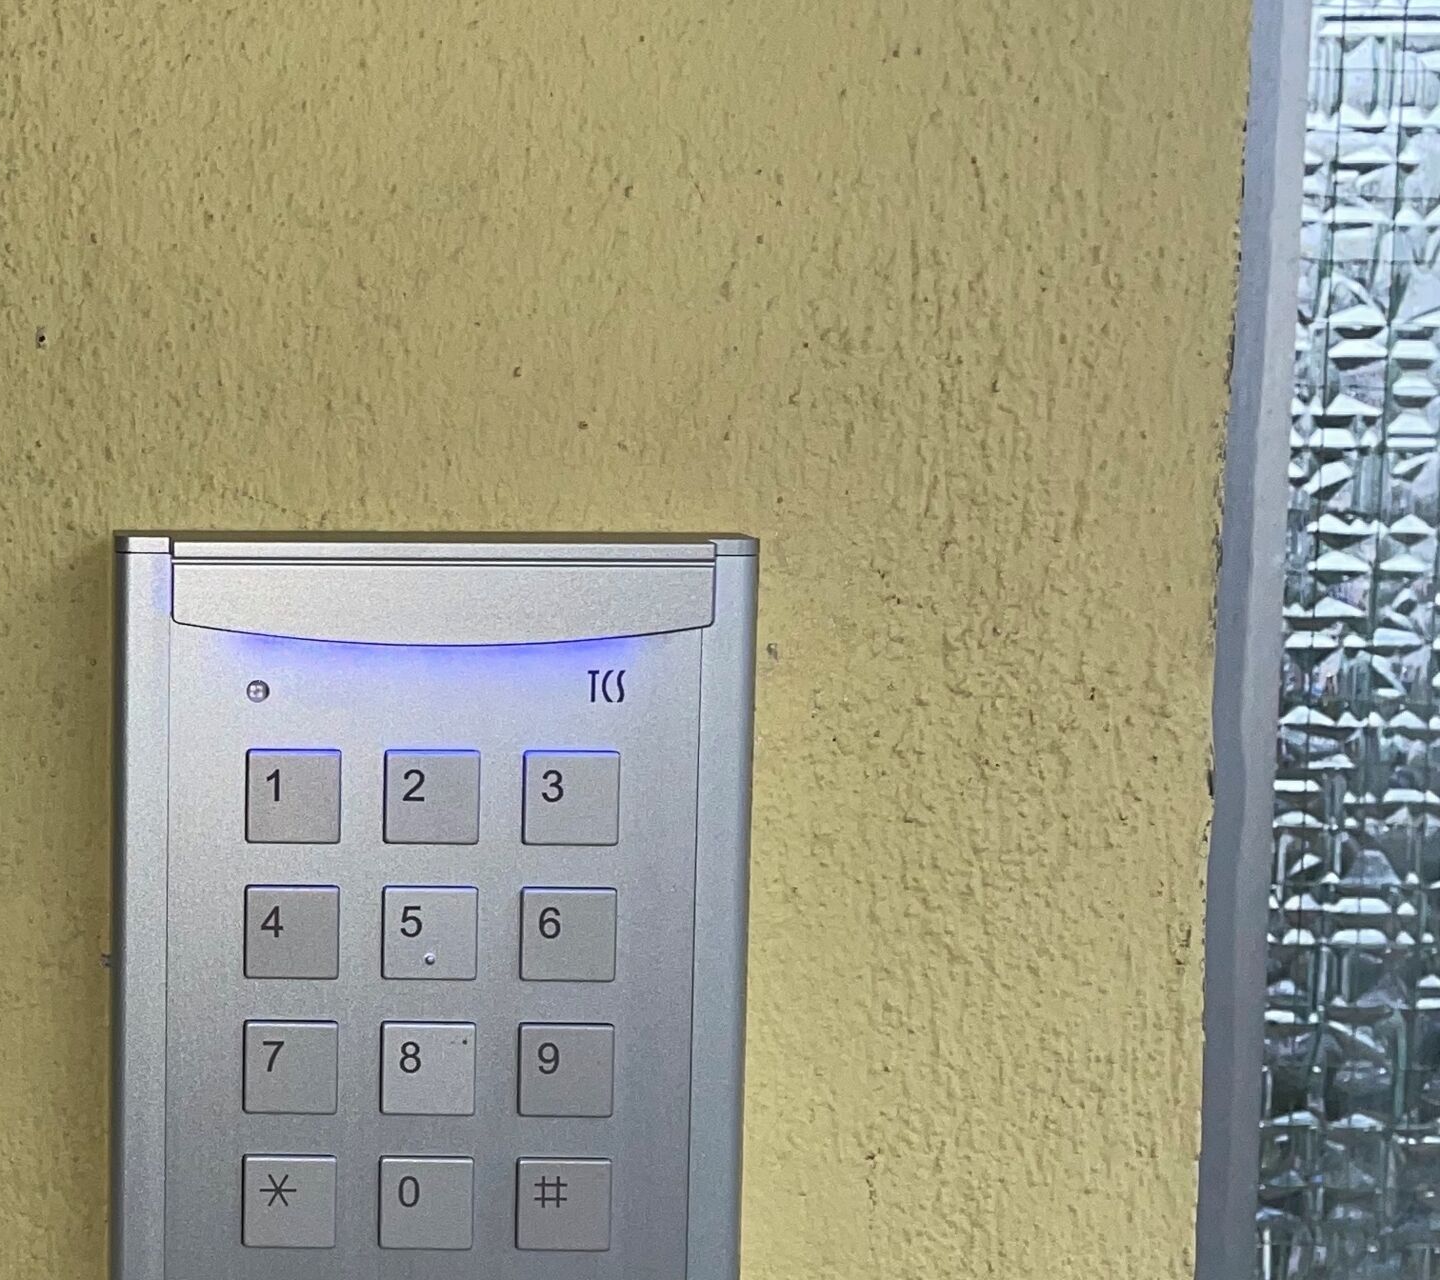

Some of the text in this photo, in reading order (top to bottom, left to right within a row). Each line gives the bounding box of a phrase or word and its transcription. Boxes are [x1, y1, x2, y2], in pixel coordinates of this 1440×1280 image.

[587, 669, 626, 704] TCS
[266, 768, 281, 802] 1
[402, 768, 426, 802] 2
[541, 769, 564, 803] 3
[260, 905, 285, 939] 4
[400, 905, 423, 938] 5
[538, 906, 561, 940] 6
[262, 1040, 285, 1073] 7
[399, 1040, 422, 1074] 8
[537, 1041, 560, 1075] 9
[397, 1175, 421, 1208] 0
[533, 1175, 569, 1209] #
